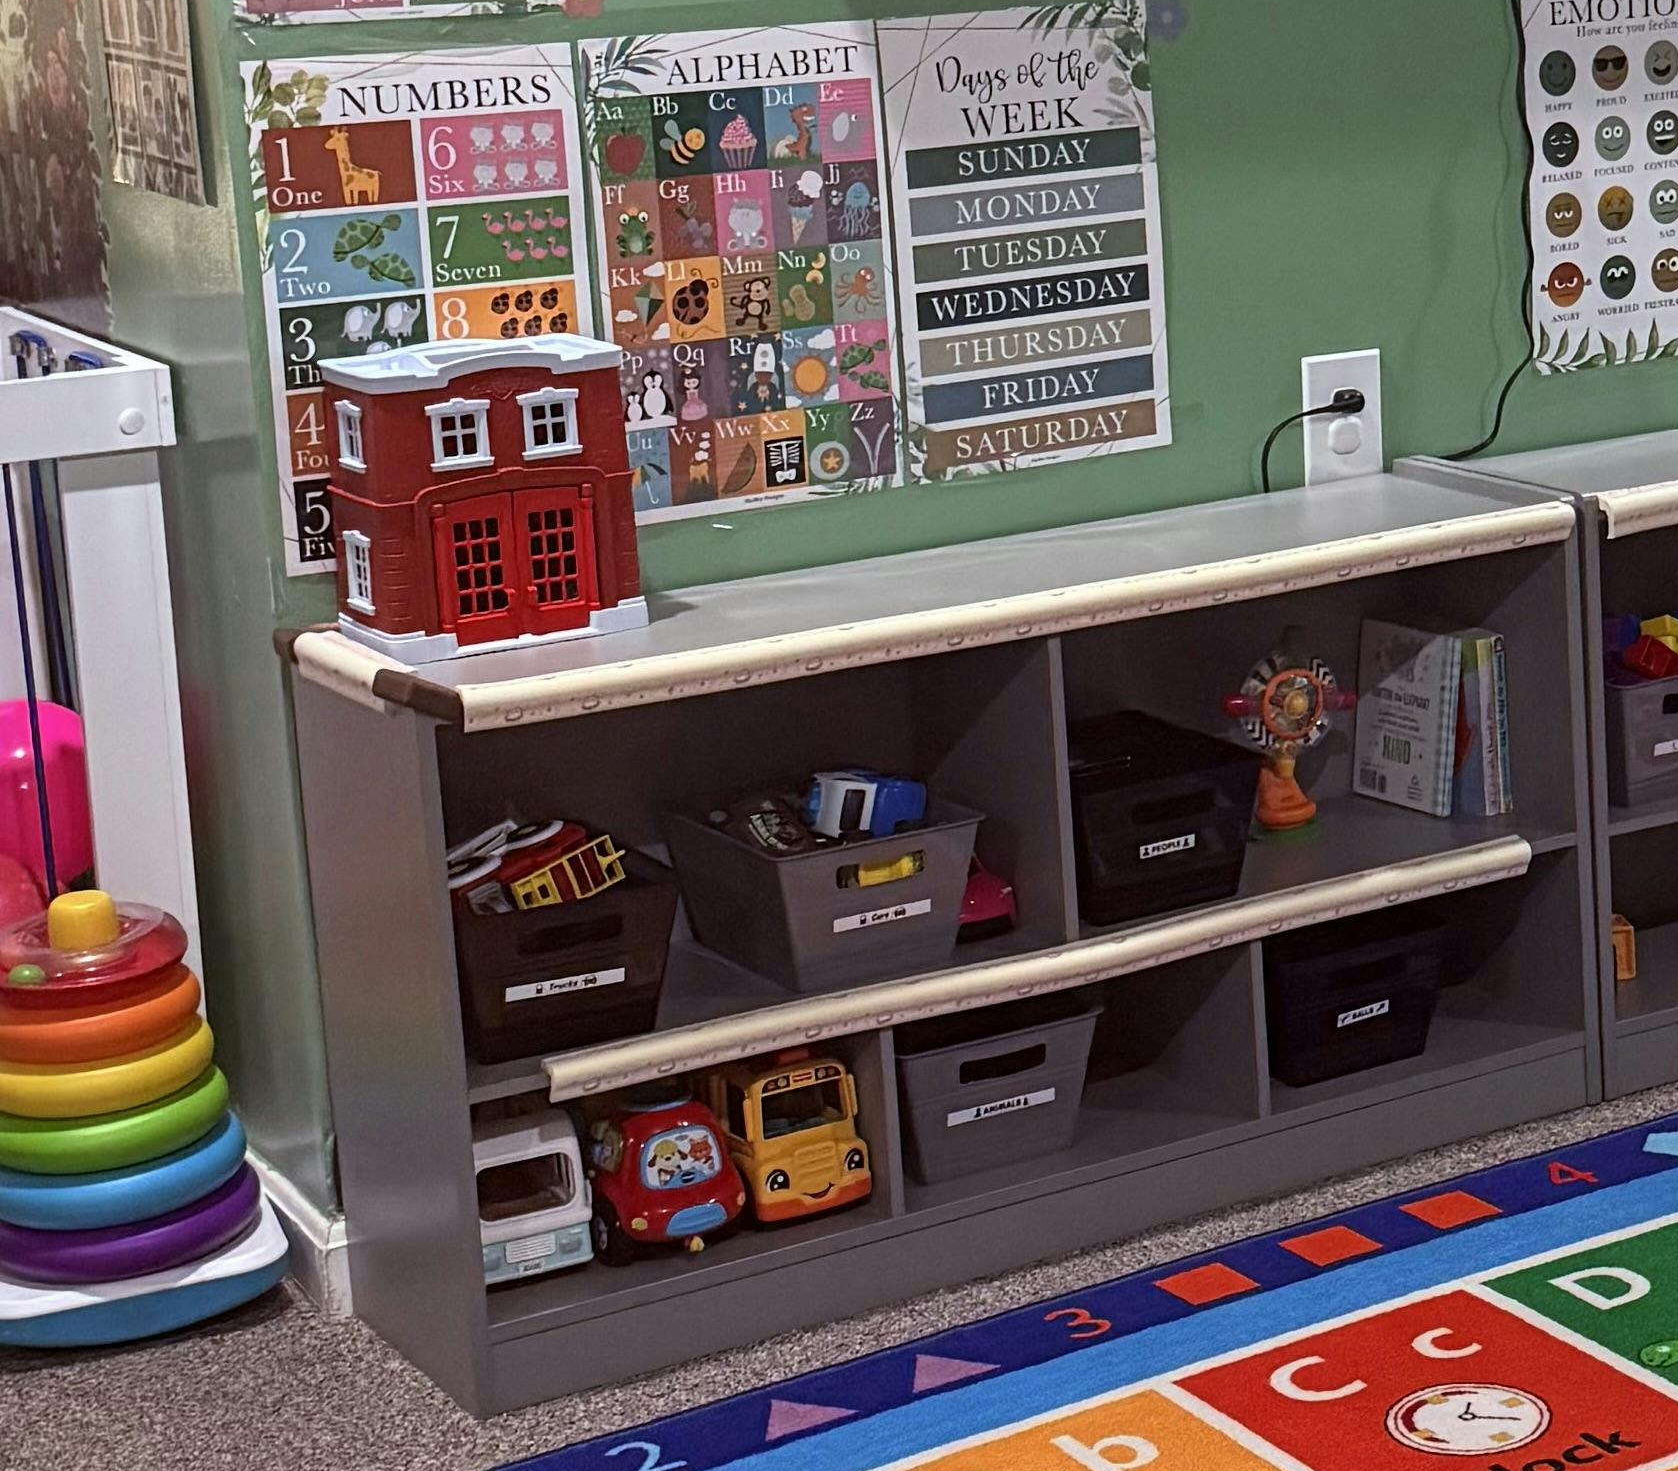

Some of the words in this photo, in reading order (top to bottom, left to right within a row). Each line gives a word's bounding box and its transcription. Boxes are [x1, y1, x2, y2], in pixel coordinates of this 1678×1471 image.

[1576, 24, 1604, 38] How
[1605, 22, 1623, 35] are
[1625, 22, 1646, 37] you
[665, 45, 859, 86] ALPHABET
[934, 55, 1009, 105] Days
[1016, 52, 1047, 89] of
[1047, 48, 1100, 91] the
[336, 74, 552, 118] NUMBERS
[708, 91, 737, 111] Cc
[763, 85, 794, 106] Dd
[818, 81, 845, 102] Ee
[1596, 95, 1628, 108] PROUD
[596, 101, 624, 122] Aa
[651, 95, 679, 116] Bb
[1544, 101, 1573, 114] HAPPY
[961, 96, 1085, 138] WEEK
[427, 125, 458, 171] 6
[958, 137, 1091, 177] SUNDAY
[274, 136, 297, 183] 1
[771, 168, 785, 189] Ii
[824, 163, 841, 185] Jj
[1593, 165, 1635, 178] FOCUSED
[429, 175, 466, 195] Six
[604, 184, 626, 205] Ff
[658, 180, 690, 203] Gg
[715, 173, 747, 195] Hh
[271, 185, 323, 208] One
[955, 183, 1101, 226] MONDAY
[435, 214, 461, 260] 7
[279, 228, 309, 275] 2
[776, 249, 806, 270] Nn
[830, 243, 861, 262] Oo
[954, 229, 1107, 271] TUESDAY
[436, 262, 502, 283] Seven
[665, 262, 687, 282] Ll
[721, 257, 763, 277] Mm
[279, 277, 331, 298] Two
[610, 268, 642, 289] Kk
[931, 271, 1136, 322] WEDNESDAY
[441, 296, 470, 340] 8
[288, 317, 317, 363] 3
[783, 331, 804, 350] Ss
[834, 322, 859, 343] Tt
[946, 318, 1127, 367] THURSDAY
[673, 343, 706, 369] Qq
[728, 337, 755, 358] Rr
[619, 350, 644, 374] Pp
[982, 367, 1100, 410] FRIDAY
[806, 408, 831, 431] Yy
[850, 401, 876, 422] Zz
[293, 401, 326, 447] 4
[715, 417, 755, 440] Ww
[760, 414, 792, 435] Xx
[956, 410, 1129, 460] SATURDAY
[627, 431, 652, 452] Uu
[670, 426, 697, 446] Vv
[303, 490, 332, 535] 5
[1151, 839, 1180, 855] PEOPLE
[1546, 1157, 1601, 1190] 4
[1045, 1307, 1114, 1340] 3
